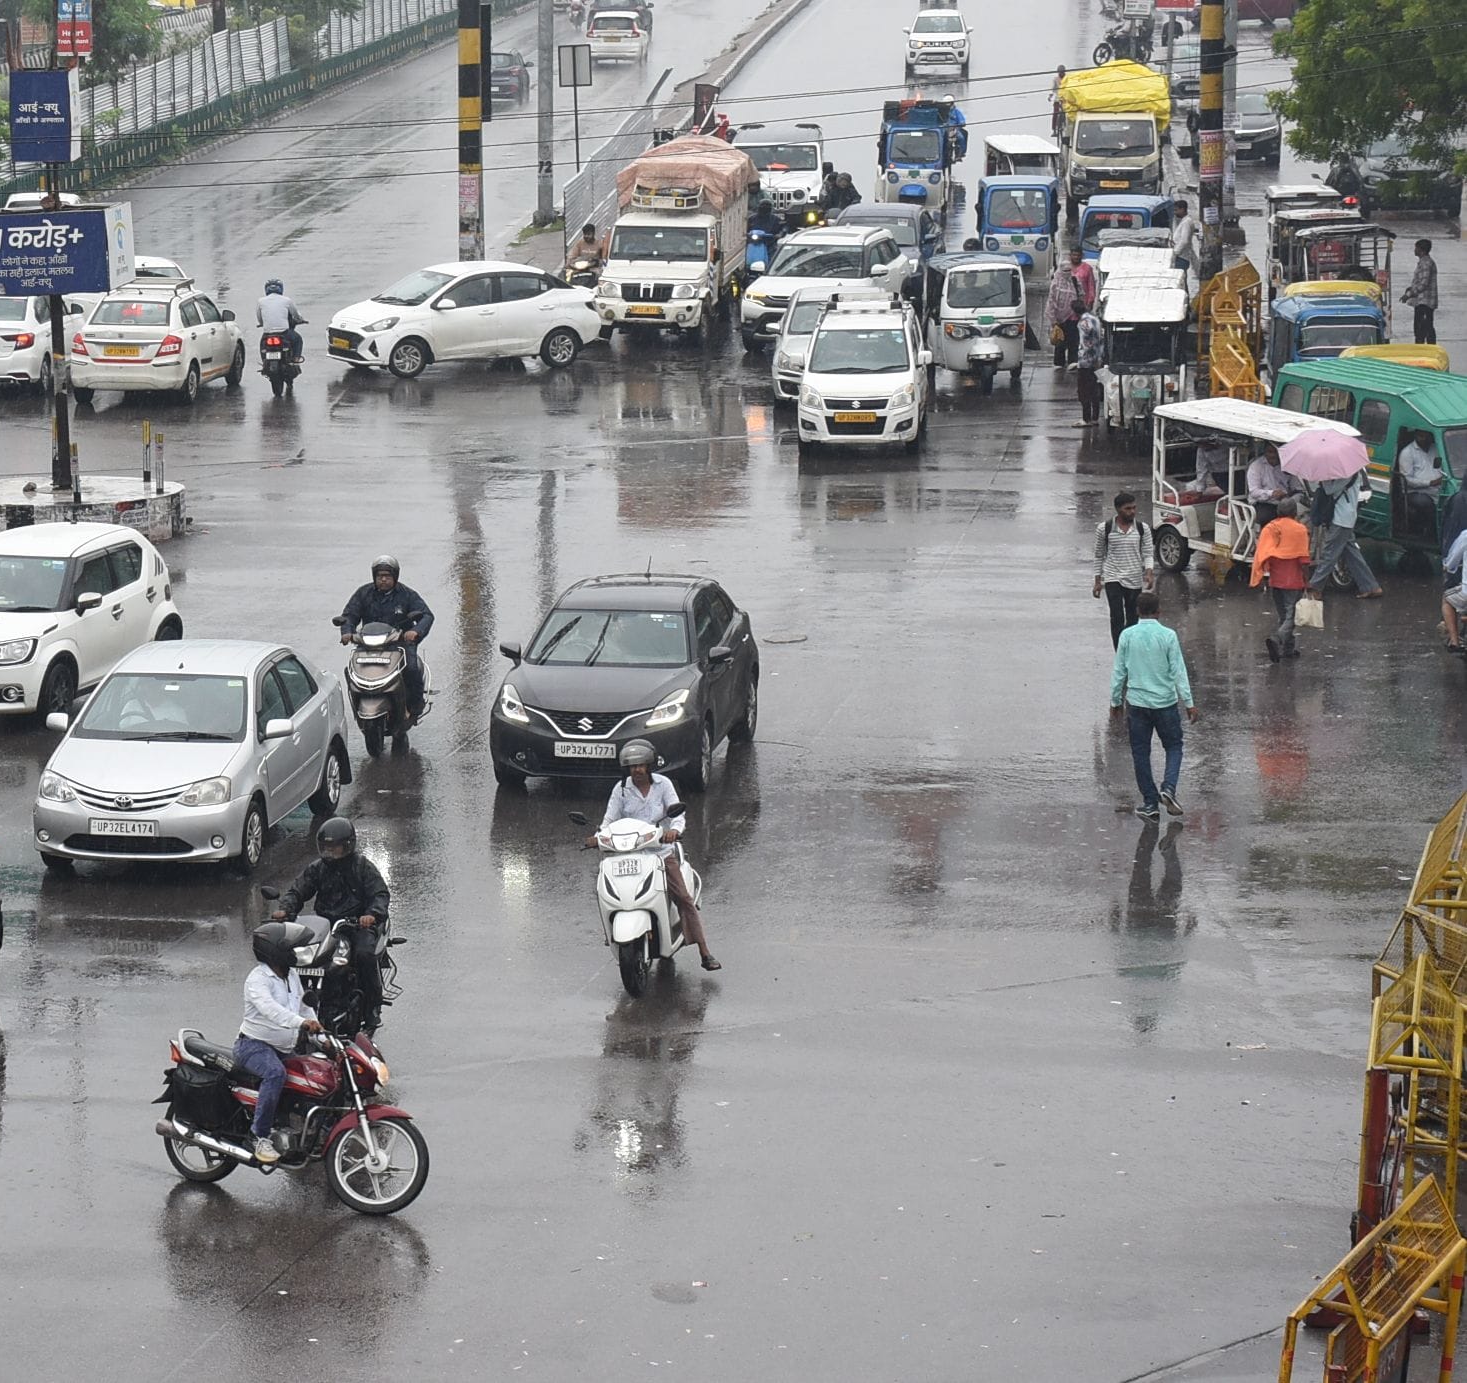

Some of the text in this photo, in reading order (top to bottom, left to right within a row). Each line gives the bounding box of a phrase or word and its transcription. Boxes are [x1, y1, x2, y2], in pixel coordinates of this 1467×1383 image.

[18, 101, 61, 115] आई-क्यू
[538, 160, 552, 173] 72
[7, 219, 84, 254] करोड़+
[20, 277, 54, 289] आई-क्यू
[560, 744, 614, 755] UP32KJ1771
[97, 819, 153, 834] UP32EL4174
